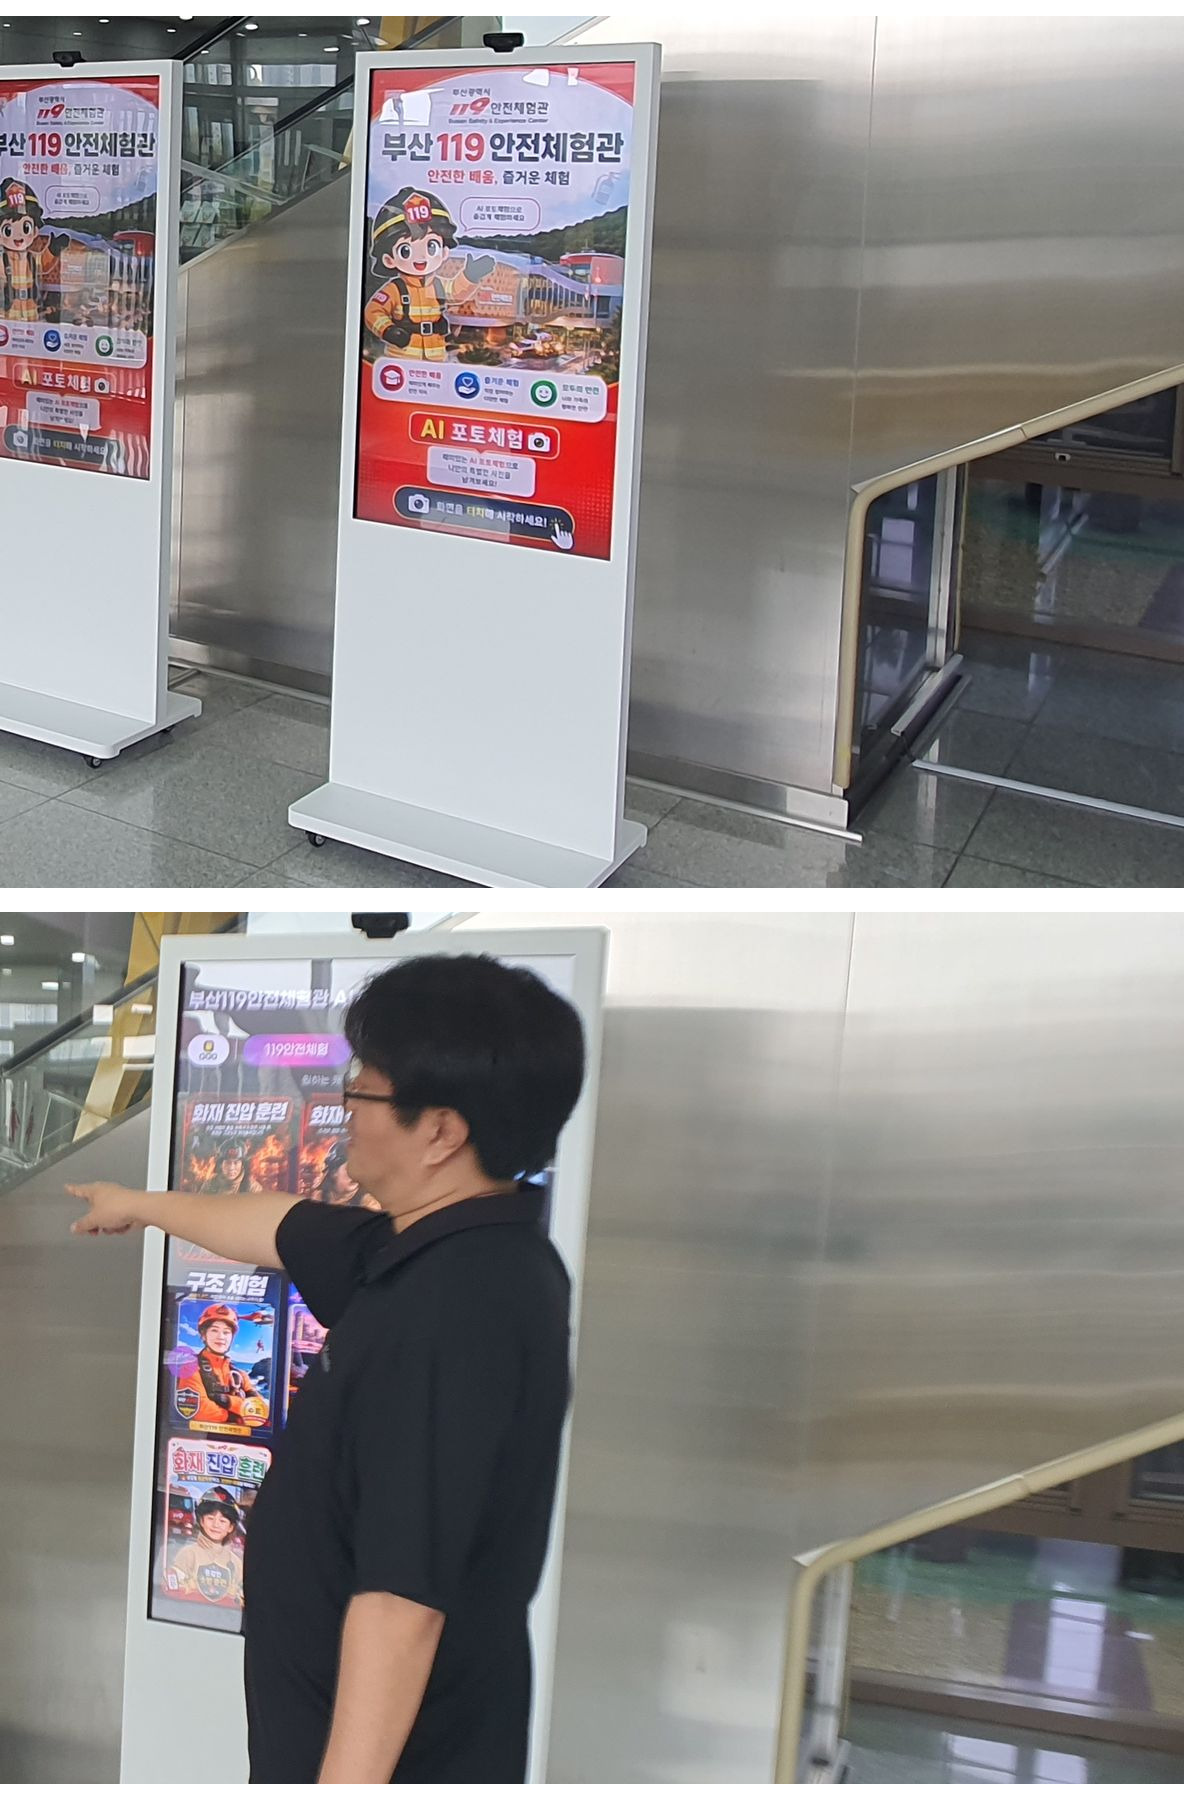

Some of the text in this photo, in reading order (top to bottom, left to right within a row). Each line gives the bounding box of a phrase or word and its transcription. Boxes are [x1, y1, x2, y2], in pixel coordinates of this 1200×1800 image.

[491, 102, 549, 115] 안전체험관
[28, 132, 62, 157] 119
[64, 133, 155, 157] 안전체험관
[382, 132, 624, 162] 부산 119 안전체험관
[22, 163, 48, 175] 안전한
[74, 163, 99, 175] 즐거운
[102, 163, 120, 176] 체험
[427, 169, 570, 185] 안전한 배움, 즐거운 체험
[8, 193, 24, 205] 119
[407, 205, 429, 220] 119
[21, 368, 37, 385] AI
[420, 417, 524, 449] AI 포토체험
[496, 509, 548, 528] 시작하세요!
[191, 1101, 289, 1124] 화재 진압 훈련
[185, 1271, 269, 1297] 구조 체험
[173, 1450, 266, 1480] 화재 진압 훈련
